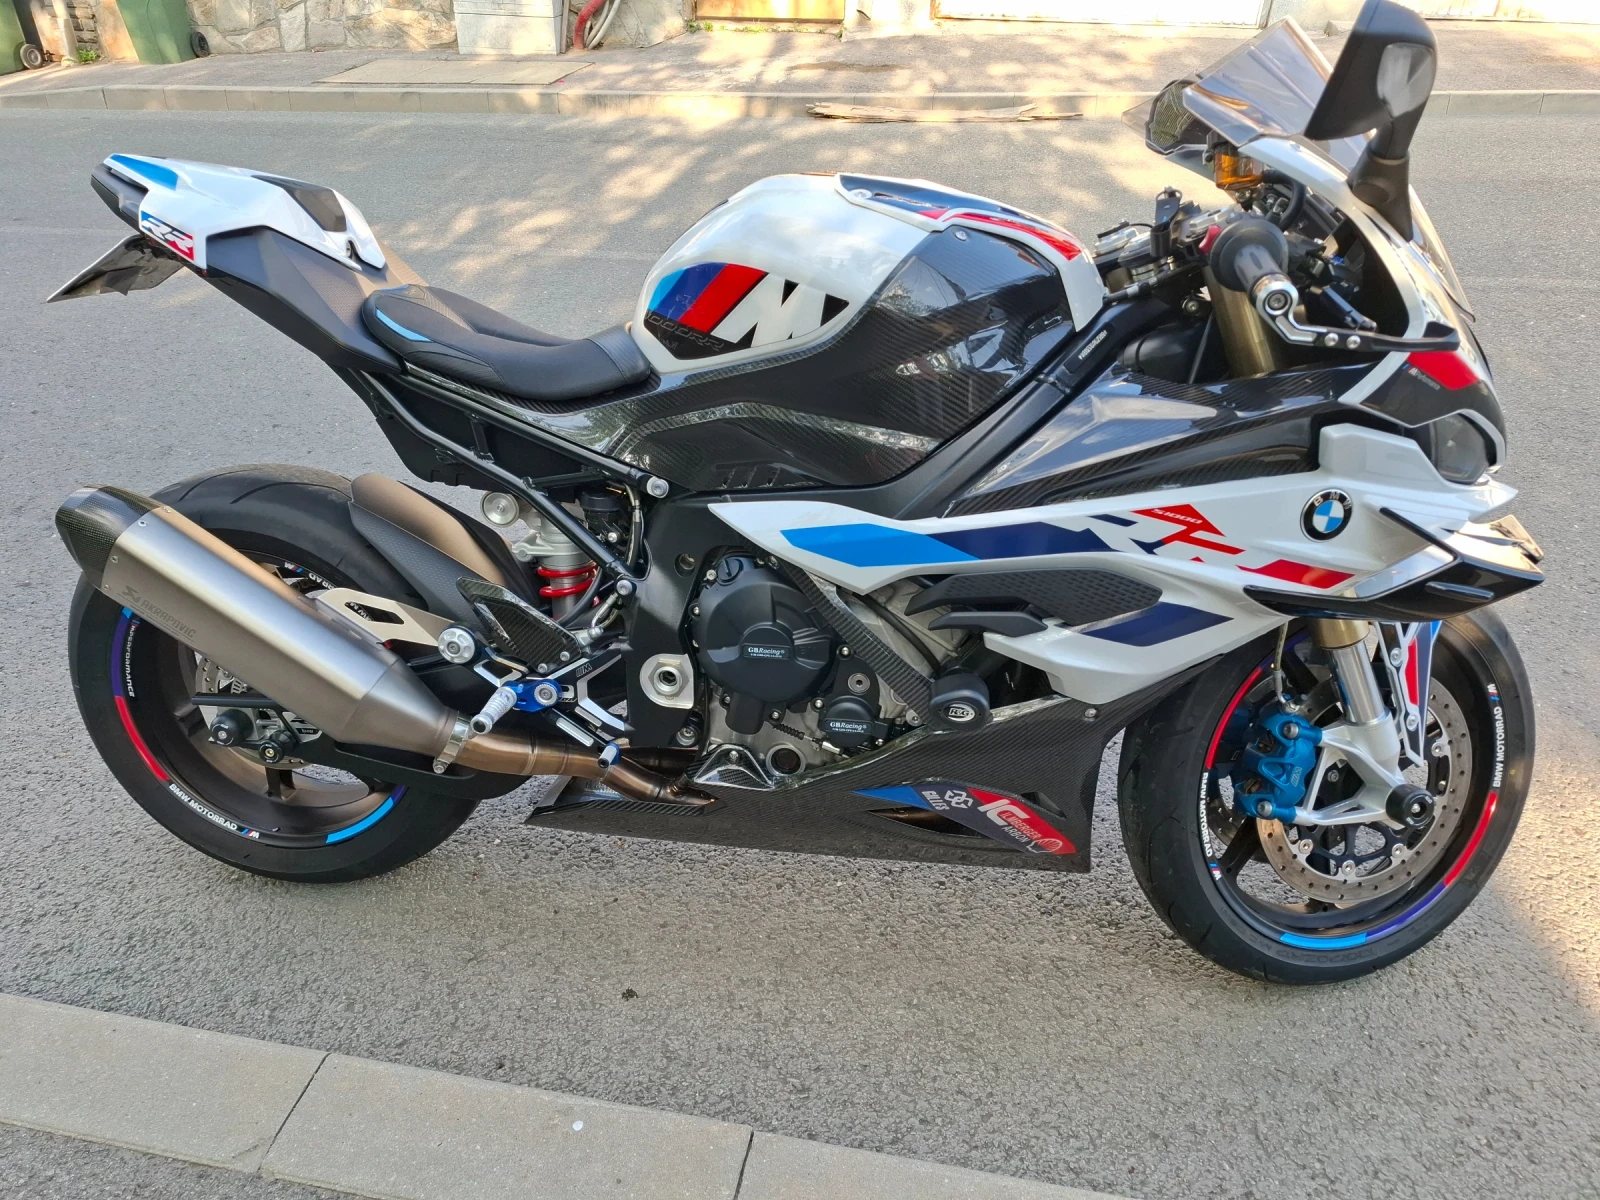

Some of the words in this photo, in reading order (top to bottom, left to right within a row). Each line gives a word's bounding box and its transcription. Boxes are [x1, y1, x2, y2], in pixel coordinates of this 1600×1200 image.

[142, 217, 194, 254] RR
[1313, 490, 1352, 510] BMW
[1151, 508, 1203, 525] S1000
[1493, 706, 1505, 762] MOTORRAD
[1200, 772, 1209, 799] BMW
[1492, 762, 1504, 788] BMW
[168, 783, 191, 803] BMW
[189, 800, 238, 831] MOTORRAD
[1199, 799, 1213, 857] MOTORRAD
